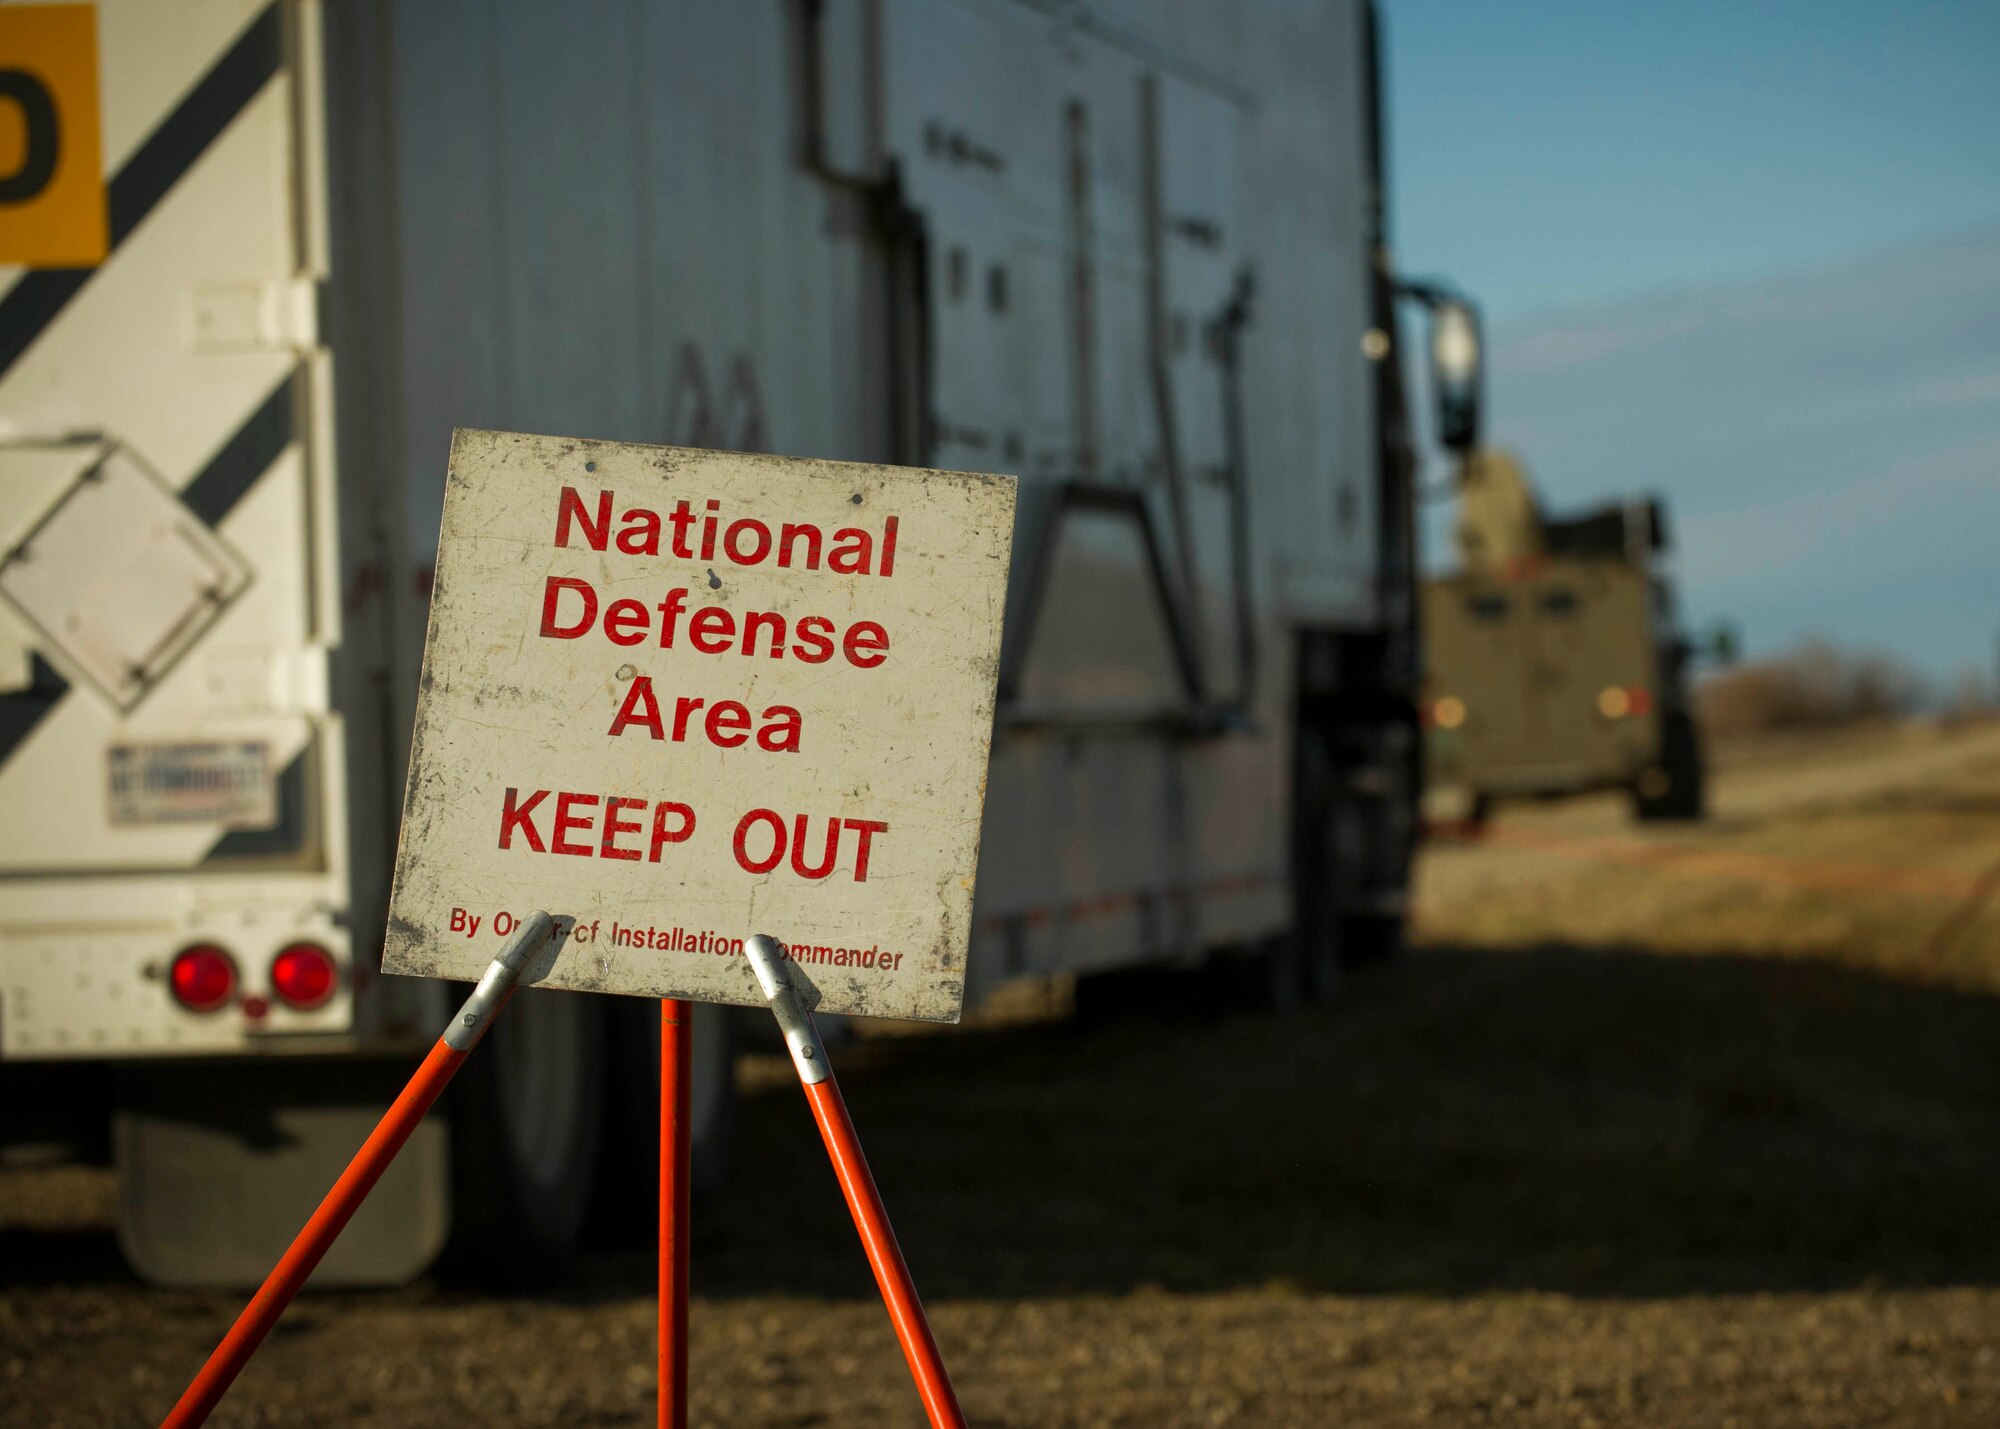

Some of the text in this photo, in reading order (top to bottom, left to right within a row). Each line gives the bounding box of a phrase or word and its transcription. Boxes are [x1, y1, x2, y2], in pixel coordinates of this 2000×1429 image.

[555, 487, 900, 577] National
[540, 576, 890, 669] Defense
[608, 675, 803, 753] Area
[499, 788, 888, 882] KEEP OUT
[450, 907, 481, 939] By
[493, 911, 562, 941] Orr
[612, 922, 744, 956] Installation
[768, 936, 904, 970] ommander
